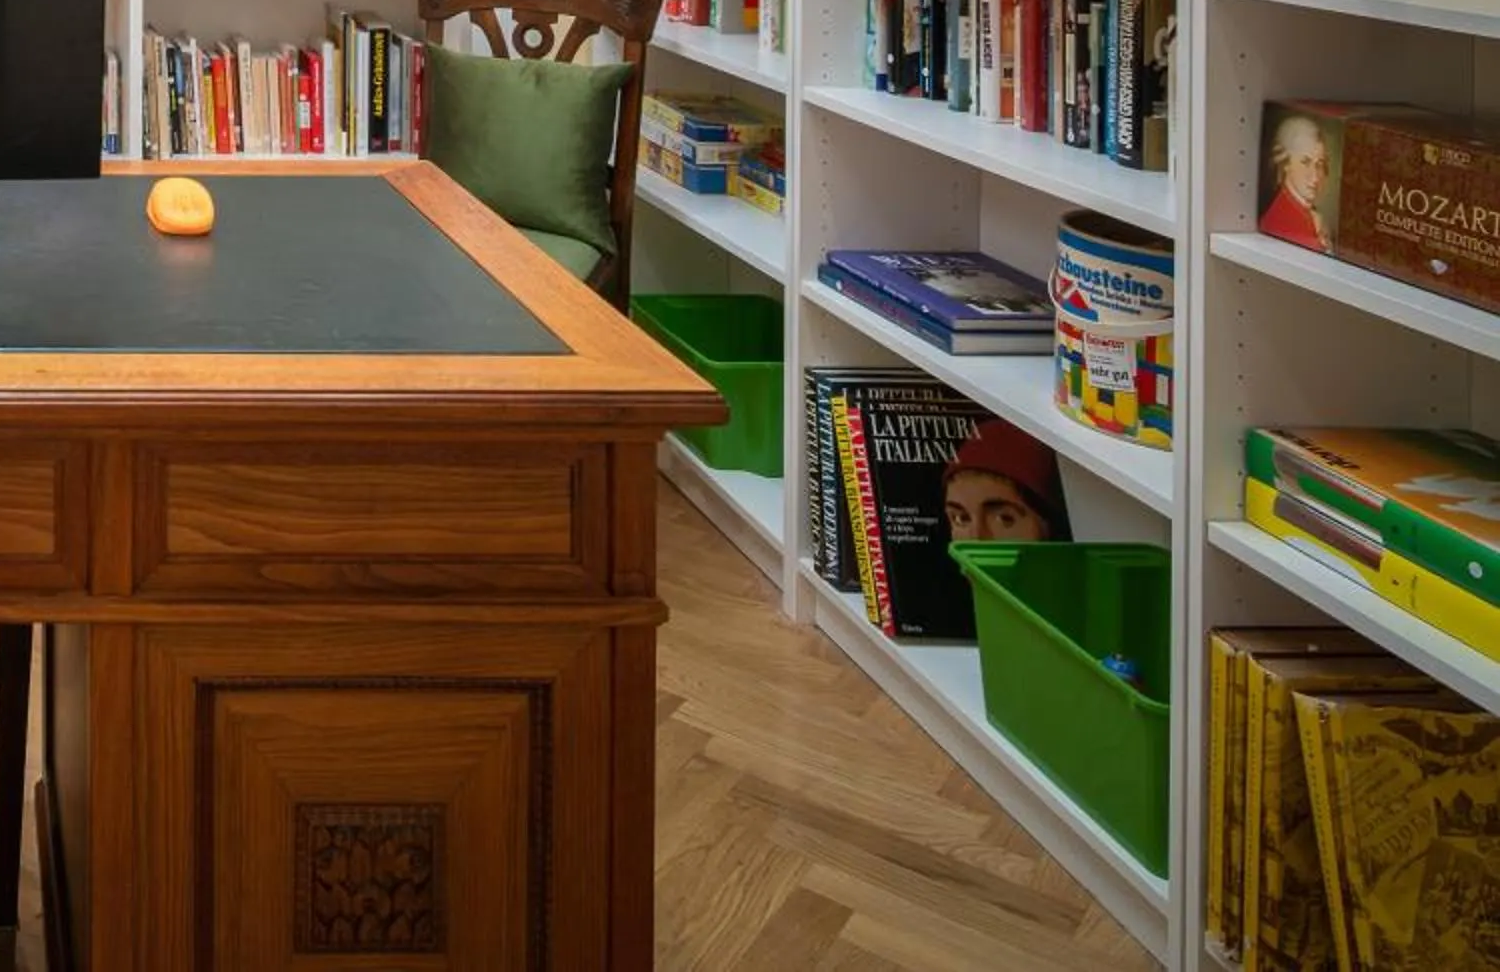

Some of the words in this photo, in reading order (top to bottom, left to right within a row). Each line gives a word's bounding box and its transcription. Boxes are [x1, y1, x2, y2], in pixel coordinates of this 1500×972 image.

[1376, 208, 1443, 241] COMPLETE
[1377, 181, 1500, 239] MOZART
[817, 382, 833, 405] LA
[847, 413, 864, 438] LA
[869, 413, 897, 438] LA
[898, 415, 983, 441] PITTURA
[817, 407, 837, 483] PITTURA
[874, 439, 961, 464] ITALIANA
[852, 441, 879, 530] PITTURA
[867, 535, 892, 629] ITALIANA
